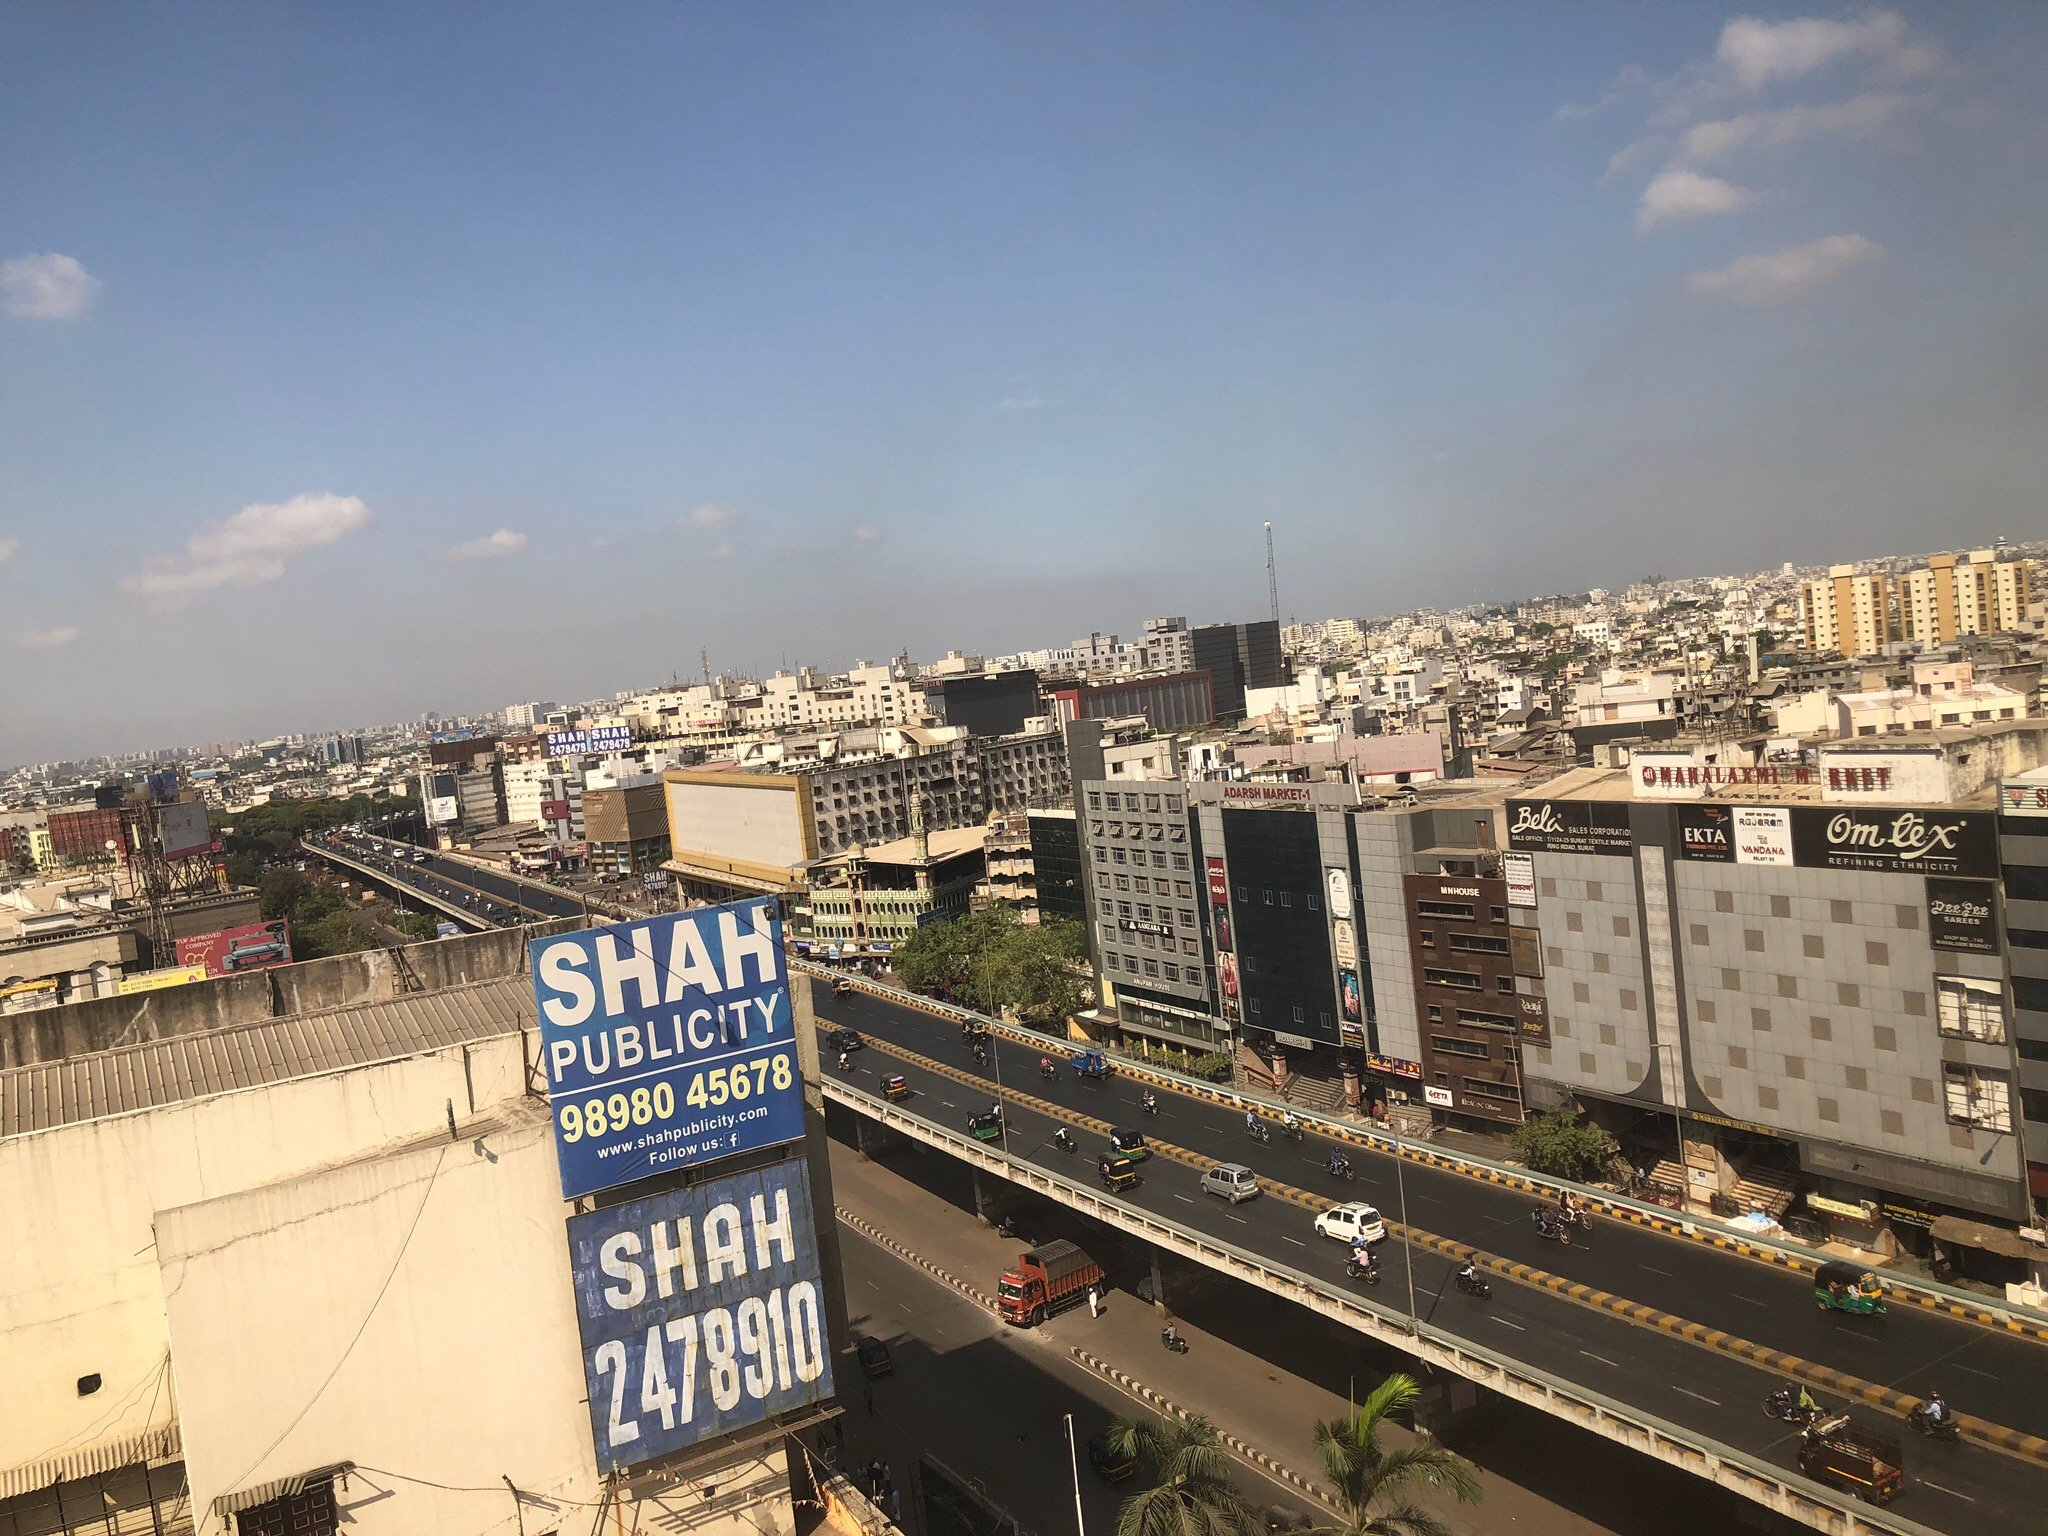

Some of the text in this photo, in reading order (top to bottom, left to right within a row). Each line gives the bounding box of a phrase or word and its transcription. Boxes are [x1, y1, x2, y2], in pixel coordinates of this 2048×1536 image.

[548, 731, 585, 744] SHAH
[591, 726, 630, 740] SHAH
[550, 743, 587, 756] 2479479
[593, 738, 631, 751] 2479479
[1224, 786, 1310, 800] ADARSH MARKET-1
[1510, 804, 1564, 834] Bela
[1568, 826, 1588, 835] SALES
[1684, 827, 1727, 843] EKTA
[1741, 845, 1785, 856] VANDANA
[1828, 857, 1959, 871] REFINING ETHNICITY
[643, 870, 667, 883] SHAH
[1944, 916, 1980, 925] SAREES
[190, 932, 222, 943] APPROVED
[185, 940, 215, 950] COMPANY
[539, 905, 777, 1027] SHAH
[551, 993, 779, 1083] PUBLICITY
[559, 1053, 792, 1144] 98980 45678
[597, 1106, 768, 1159] www.shahpublicity.com
[649, 1144, 698, 1166] Follow
[599, 1188, 796, 1310] SHAH
